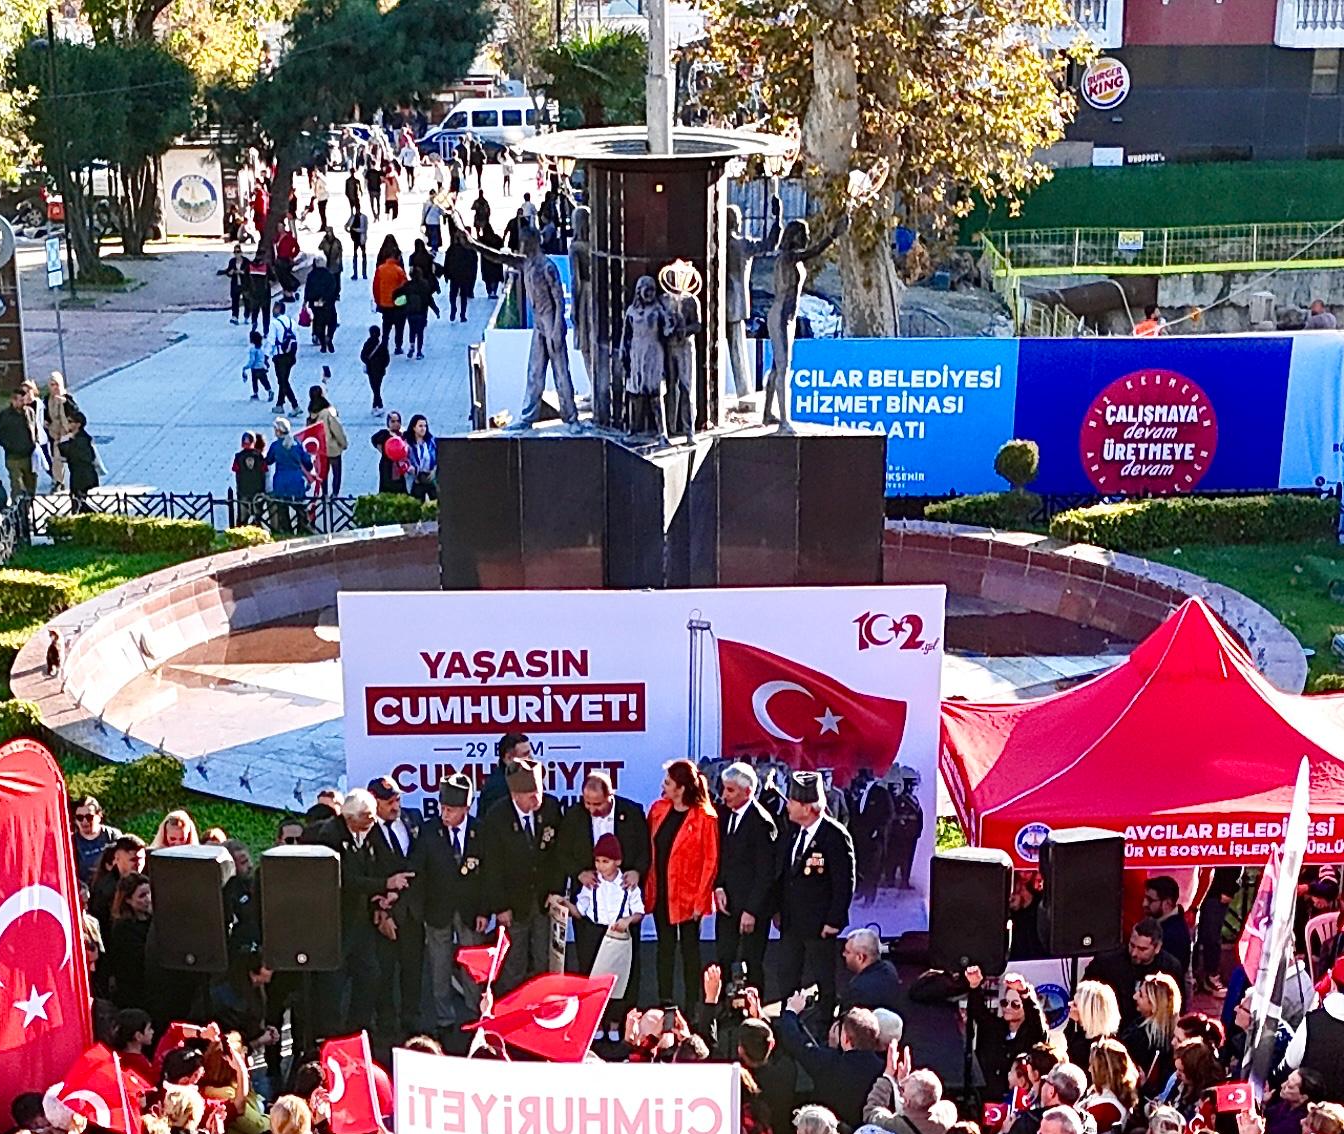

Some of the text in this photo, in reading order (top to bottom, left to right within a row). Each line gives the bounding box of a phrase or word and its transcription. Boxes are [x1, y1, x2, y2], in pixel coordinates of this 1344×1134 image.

[1088, 67, 1122, 86] BURGER
[1089, 76, 1124, 97] KING
[867, 364, 1002, 389] BELEDİYESİ
[796, 390, 964, 413] HİZMET BİNASI
[1105, 404, 1198, 425] ÇALIŞMAYA
[1123, 420, 1178, 439] devam
[1103, 438, 1196, 460] ÜRETMEYE
[1120, 459, 1174, 476] devam
[420, 650, 589, 684] YAŞASIN
[374, 686, 637, 725] CUMHURİYET!
[466, 741, 544, 757] 29 EM
[1124, 816, 1336, 841] AVCILAR BELEDİESİ
[1148, 845, 1167, 857] VE
[1169, 843, 1226, 857] SOSYAL
[1230, 840, 1270, 858] İŞLER
